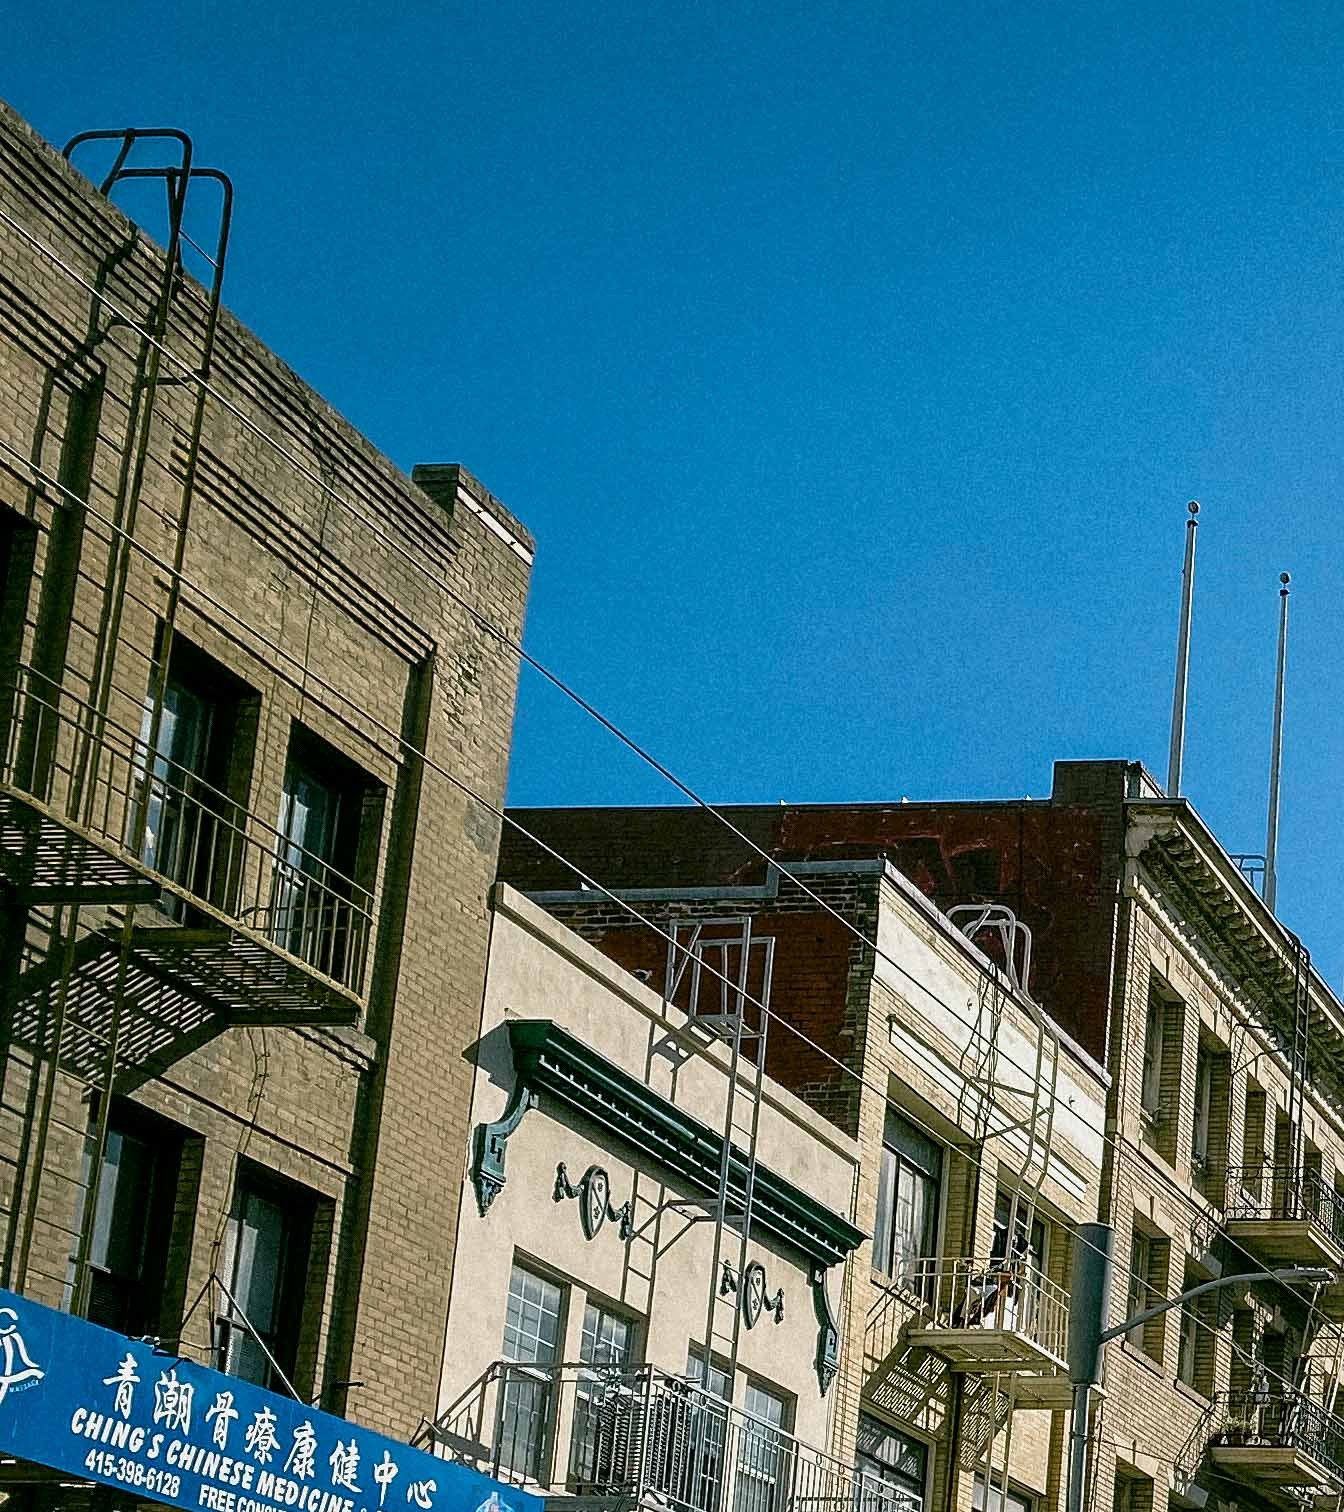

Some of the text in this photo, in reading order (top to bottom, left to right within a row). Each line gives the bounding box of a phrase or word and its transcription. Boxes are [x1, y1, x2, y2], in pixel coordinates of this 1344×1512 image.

[72, 1408, 164, 1458] CHING'S
[167, 1440, 254, 1490] CHINESE
[85, 1449, 181, 1497] 415-398-6128
